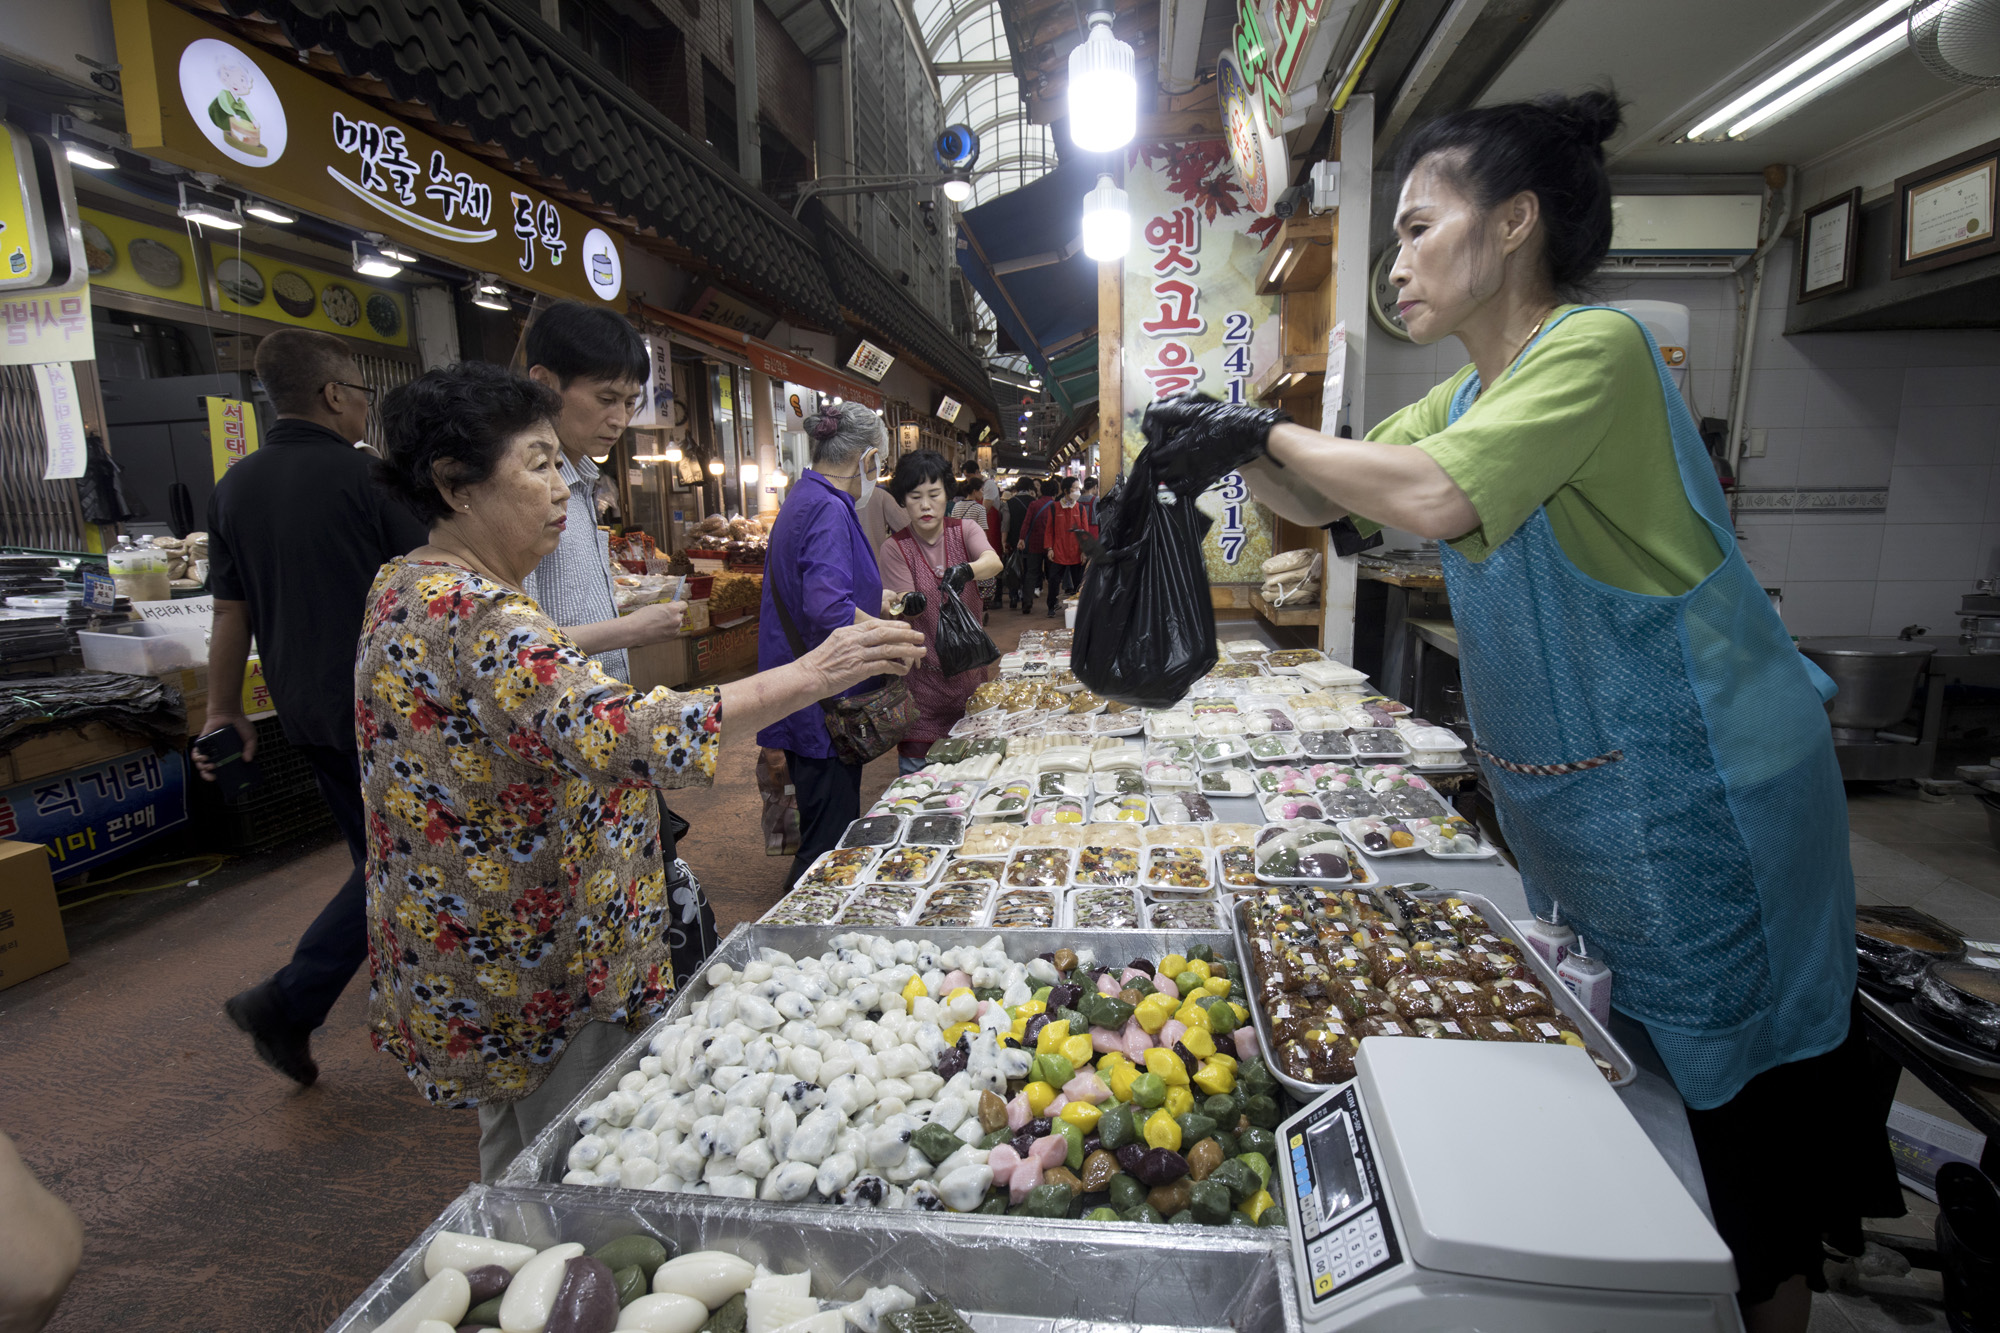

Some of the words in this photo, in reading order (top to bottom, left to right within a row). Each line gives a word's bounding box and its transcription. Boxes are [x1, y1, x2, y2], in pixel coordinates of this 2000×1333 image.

[333, 112, 421, 205] 맷돌
[425, 150, 492, 225] 수제
[511, 191, 567, 272] 두부
[656, 346, 669, 417] 금산인삼
[141, 605, 184, 620] 서리태
[33, 751, 163, 816] 직거래
[106, 804, 156, 842] 판매
[1334, 1253, 1342, 1261] 2
[1351, 1243, 1360, 1251] 5
[1369, 1232, 1377, 1240] 8
[1373, 1249, 1382, 1257] 9
[1313, 1246, 1322, 1254] 0
[1319, 1279, 1329, 1289] C
[1337, 1270, 1346, 1278] 3
[1355, 1260, 1364, 1268] 6
